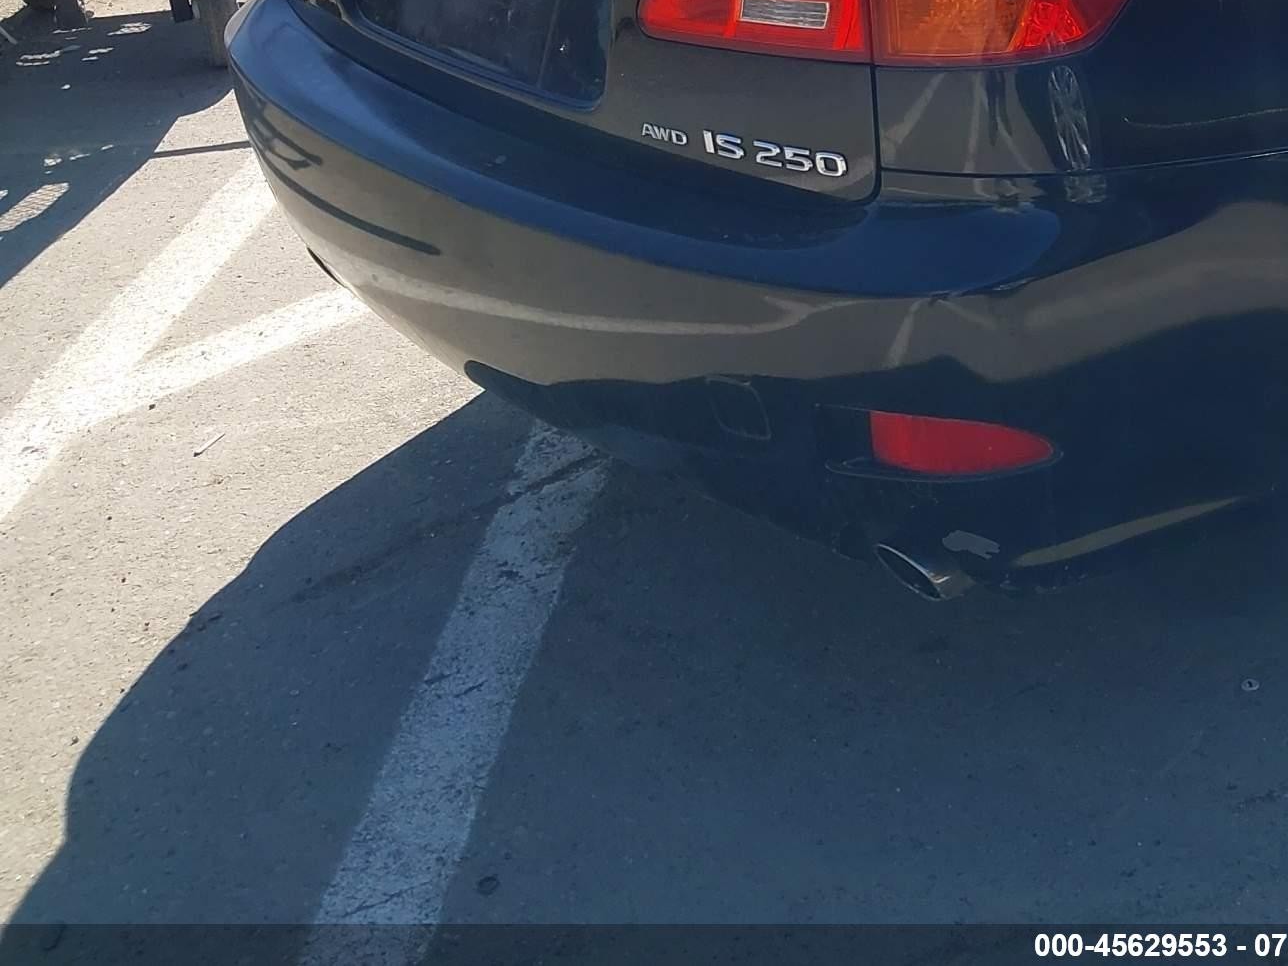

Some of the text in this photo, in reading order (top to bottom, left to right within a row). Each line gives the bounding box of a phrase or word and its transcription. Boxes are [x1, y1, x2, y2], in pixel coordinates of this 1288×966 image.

[641, 122, 848, 177] AWD IS 250
